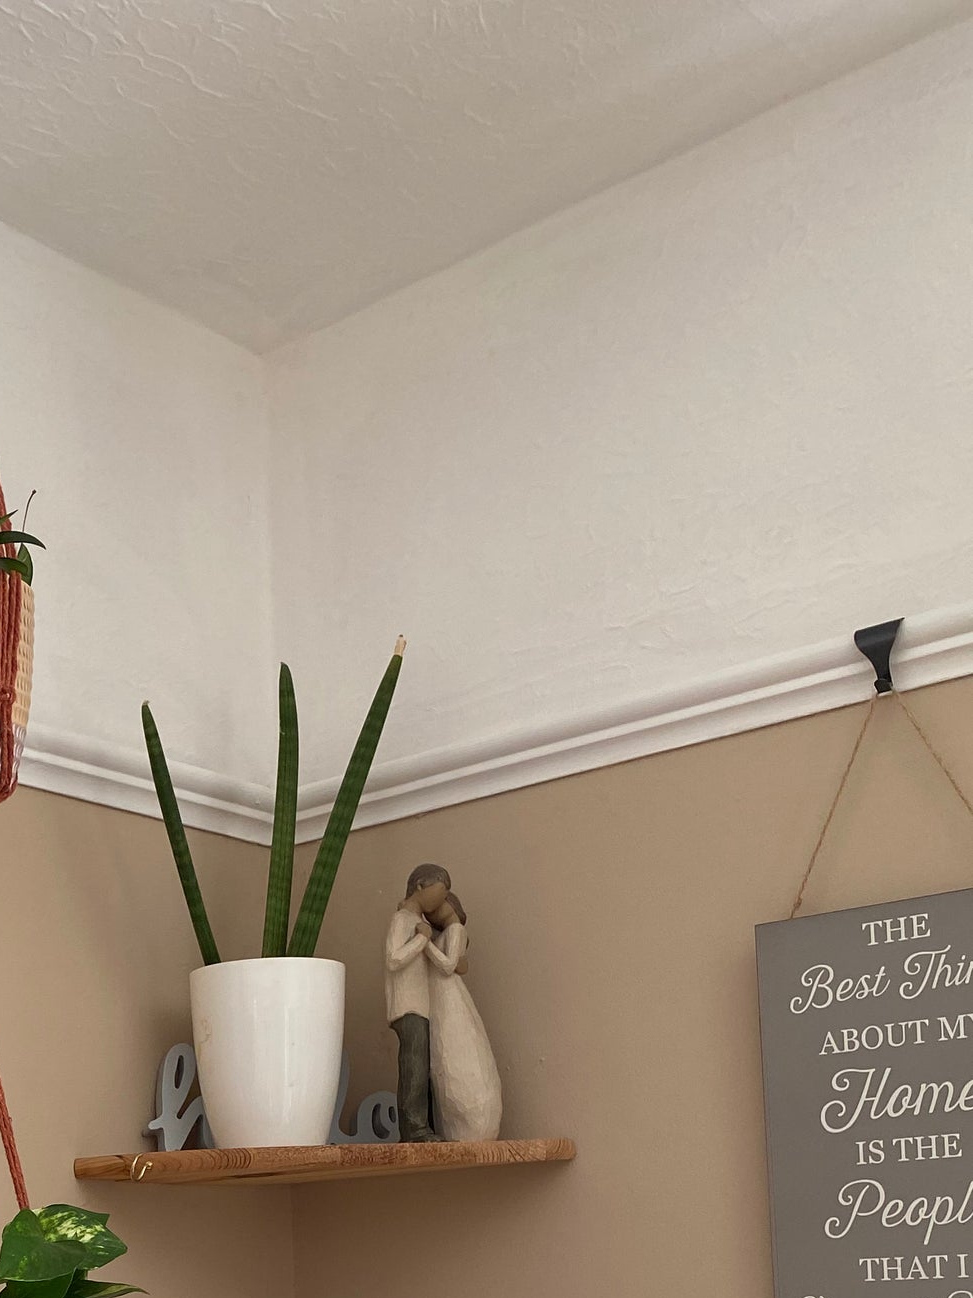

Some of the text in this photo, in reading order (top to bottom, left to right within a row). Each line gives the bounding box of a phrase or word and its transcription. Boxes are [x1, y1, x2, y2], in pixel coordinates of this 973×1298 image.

[861, 912, 931, 946] THE
[789, 963, 890, 1014] Best
[818, 1012, 973, 1055] ABOUT M
[820, 1067, 973, 1134] Home
[855, 1133, 963, 1165] IS THE
[824, 1178, 973, 1246] Peopl
[859, 1253, 969, 1282] THAT I
